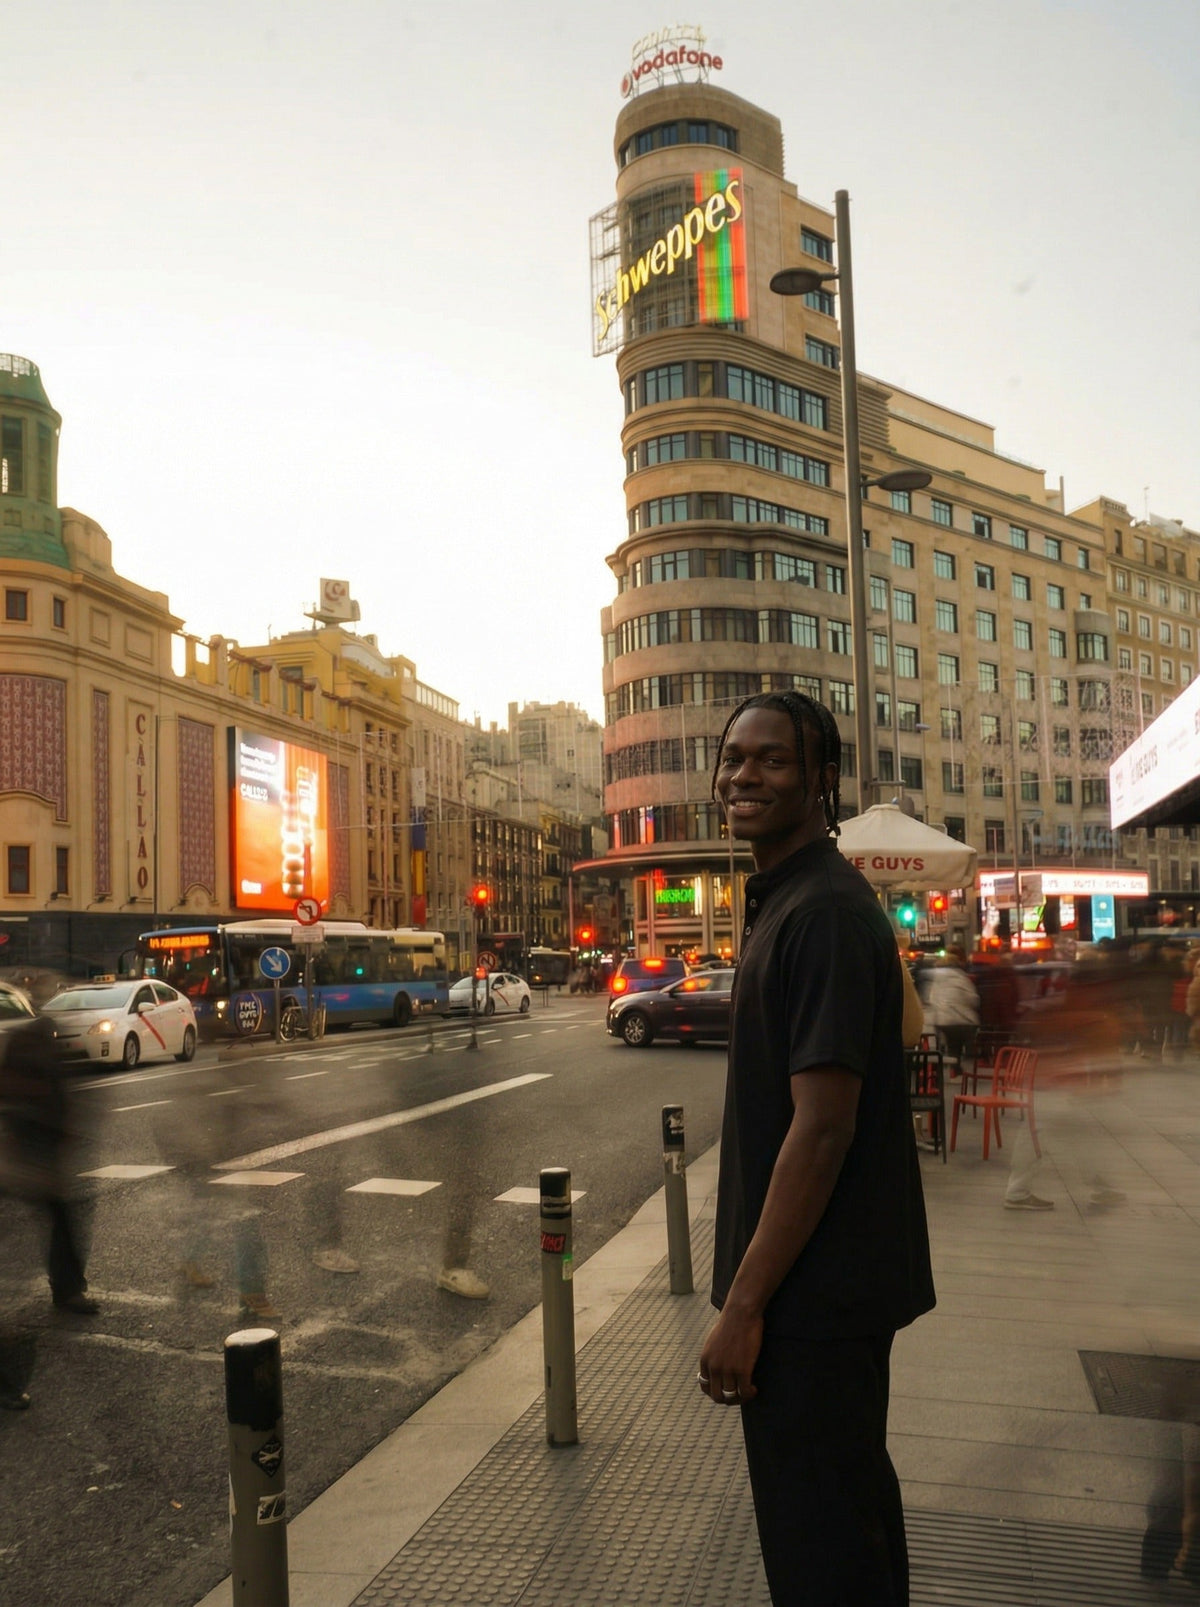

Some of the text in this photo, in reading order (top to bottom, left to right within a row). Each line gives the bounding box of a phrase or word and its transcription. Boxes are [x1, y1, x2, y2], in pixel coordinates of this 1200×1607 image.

[632, 45, 723, 81] vodafone
[596, 180, 742, 340] Schweppes
[136, 713, 149, 890] CALLAO
[871, 856, 925, 871] GUYS
